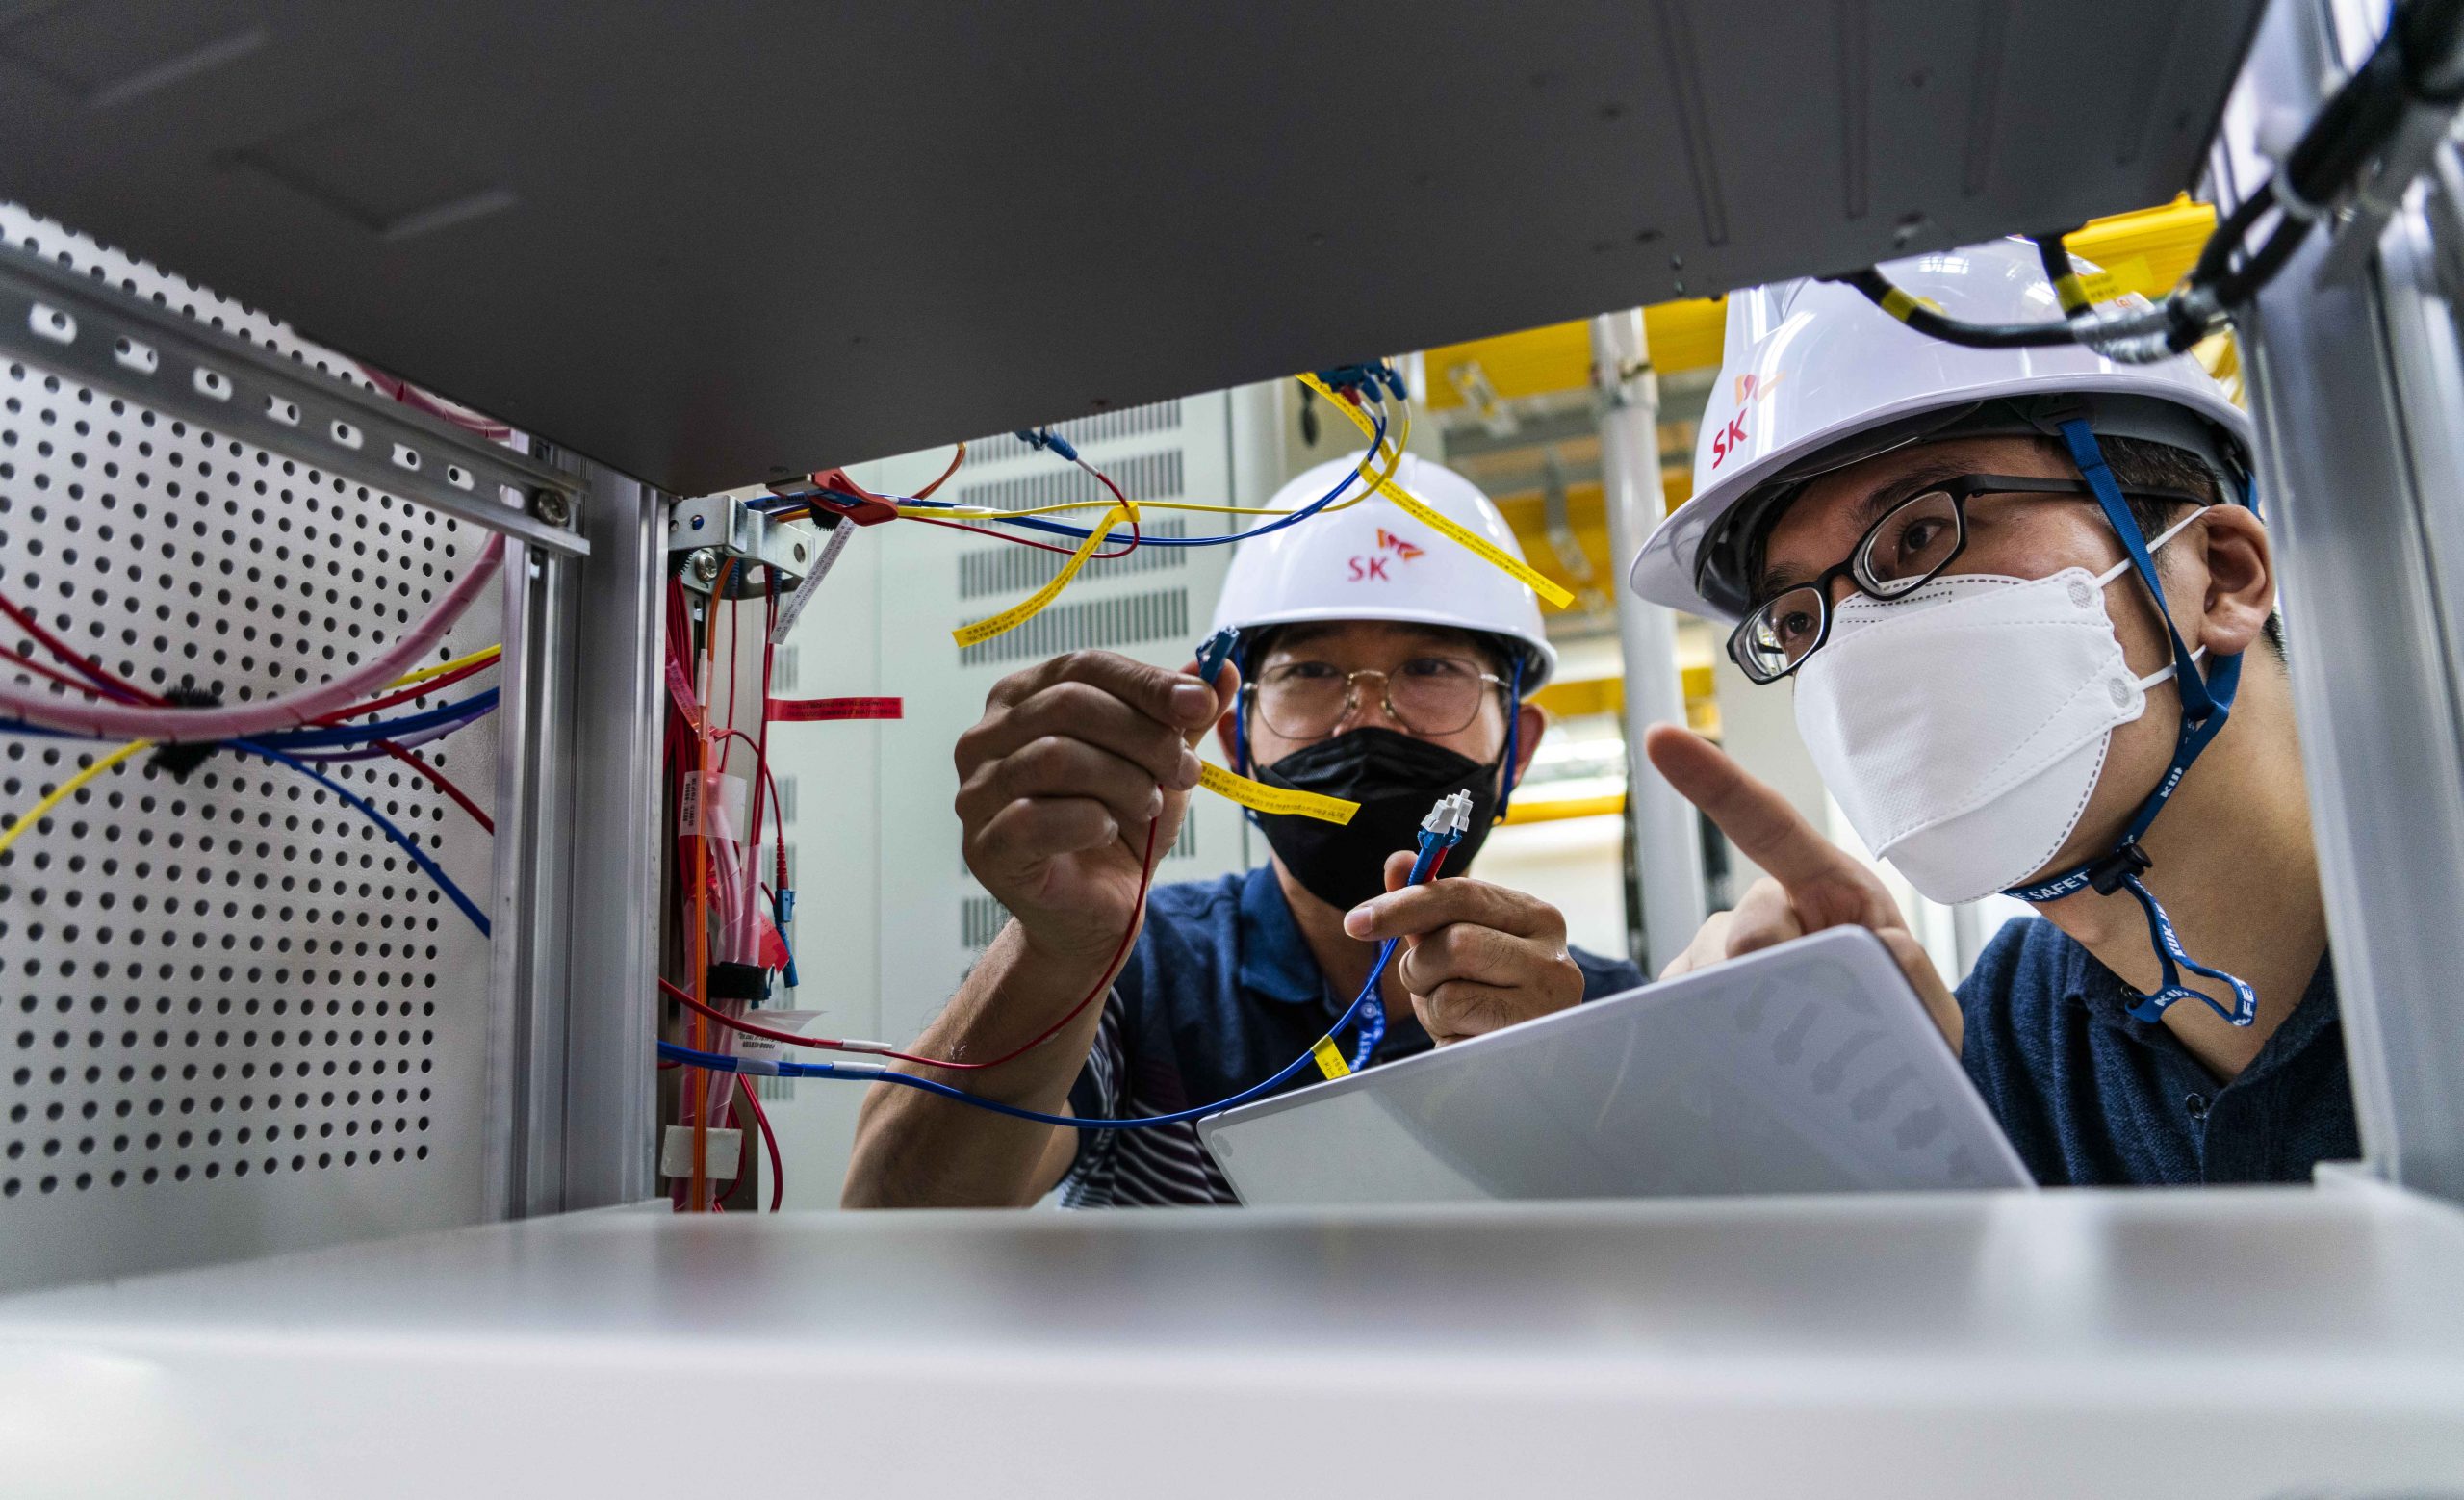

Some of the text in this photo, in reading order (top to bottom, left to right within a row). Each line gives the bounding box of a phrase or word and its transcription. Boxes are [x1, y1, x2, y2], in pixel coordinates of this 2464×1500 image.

[1712, 407, 1748, 471] SK
[1348, 556, 1389, 582] SK
[2028, 869, 2091, 900] SAFET
